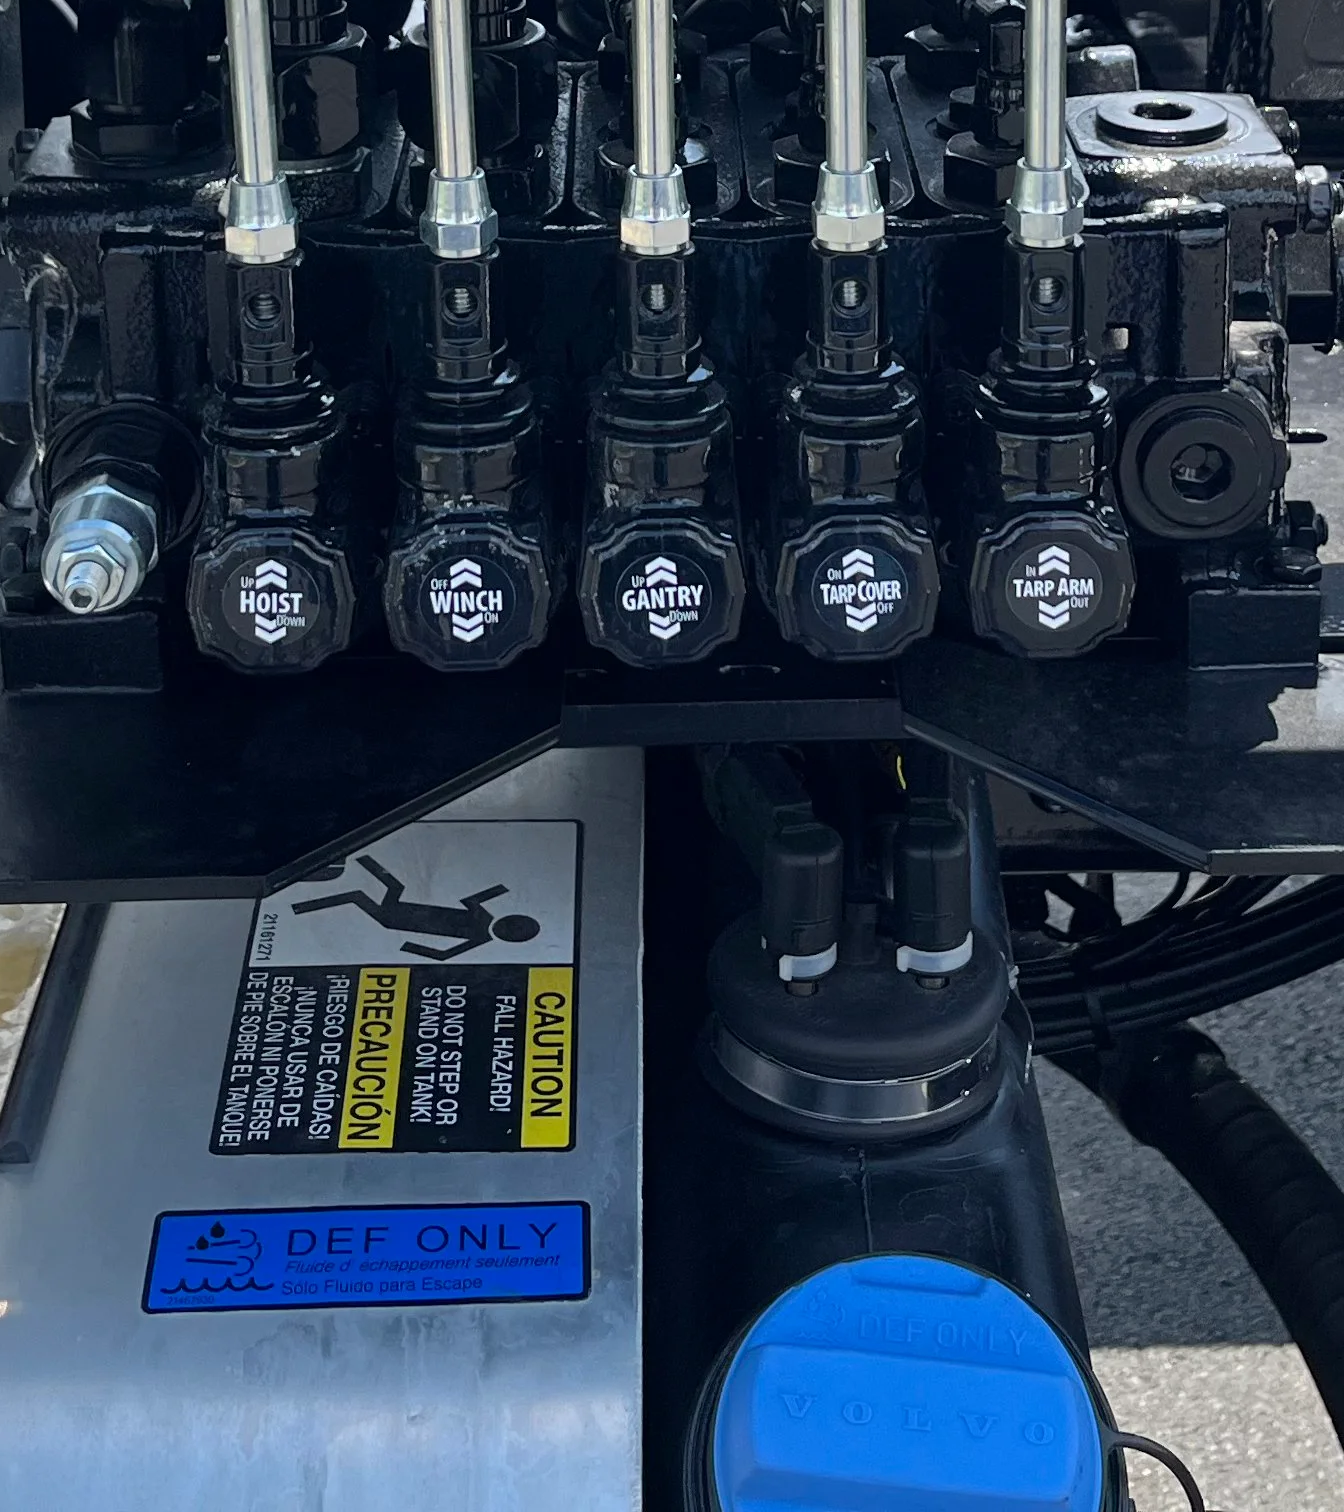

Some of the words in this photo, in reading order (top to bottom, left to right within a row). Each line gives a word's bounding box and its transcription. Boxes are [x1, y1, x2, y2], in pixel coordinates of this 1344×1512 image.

[239, 591, 303, 614] HOIST
[429, 590, 503, 614] WINCH
[622, 584, 703, 611] GANTRY
[820, 582, 856, 605] TARP
[857, 579, 902, 603] COVER
[1013, 578, 1055, 599] TARP
[1057, 577, 1095, 597] ARM
[256, 913, 278, 962] 21161271
[247, 972, 269, 989] DE
[445, 985, 467, 1008] DO
[243, 992, 266, 1013] PIE
[265, 976, 295, 1043] ESCALÓN
[289, 986, 318, 1048] ¡NUNCA
[322, 974, 350, 1039] ¡RIESGO
[417, 987, 442, 1037] STAND
[494, 995, 517, 1033] FALL
[234, 1015, 261, 1062] SOBRE
[441, 1011, 465, 1045] NOT
[259, 1046, 283, 1062] NI
[318, 1042, 342, 1066] DE
[346, 973, 397, 1141] PRECAUCIÓN
[414, 1043, 437, 1068] ON
[438, 1049, 463, 1094] STEP
[530, 991, 566, 1118] CAUTION
[230, 1064, 253, 1082] EL
[282, 1051, 308, 1099] USAR
[489, 1037, 514, 1112] HAZARD!
[218, 1084, 250, 1147] TANQUE!
[247, 1066, 280, 1141] PONERSE
[277, 1103, 302, 1128] DE
[308, 1069, 341, 1140] CAÍDAS!
[409, 1073, 436, 1124] TANK!
[435, 1099, 458, 1126] OR
[287, 1226, 389, 1256] DEF
[416, 1222, 557, 1253] ONLY
[284, 1258, 335, 1273] Fluide
[475, 1254, 561, 1269] seulement
[324, 1278, 374, 1294] Fluido
[379, 1279, 416, 1295] para
[421, 1276, 483, 1292] Escape
[860, 1314, 927, 1344] DEF
[936, 1322, 1028, 1356] ONLY
[781, 1393, 1055, 1445] VOLVO
